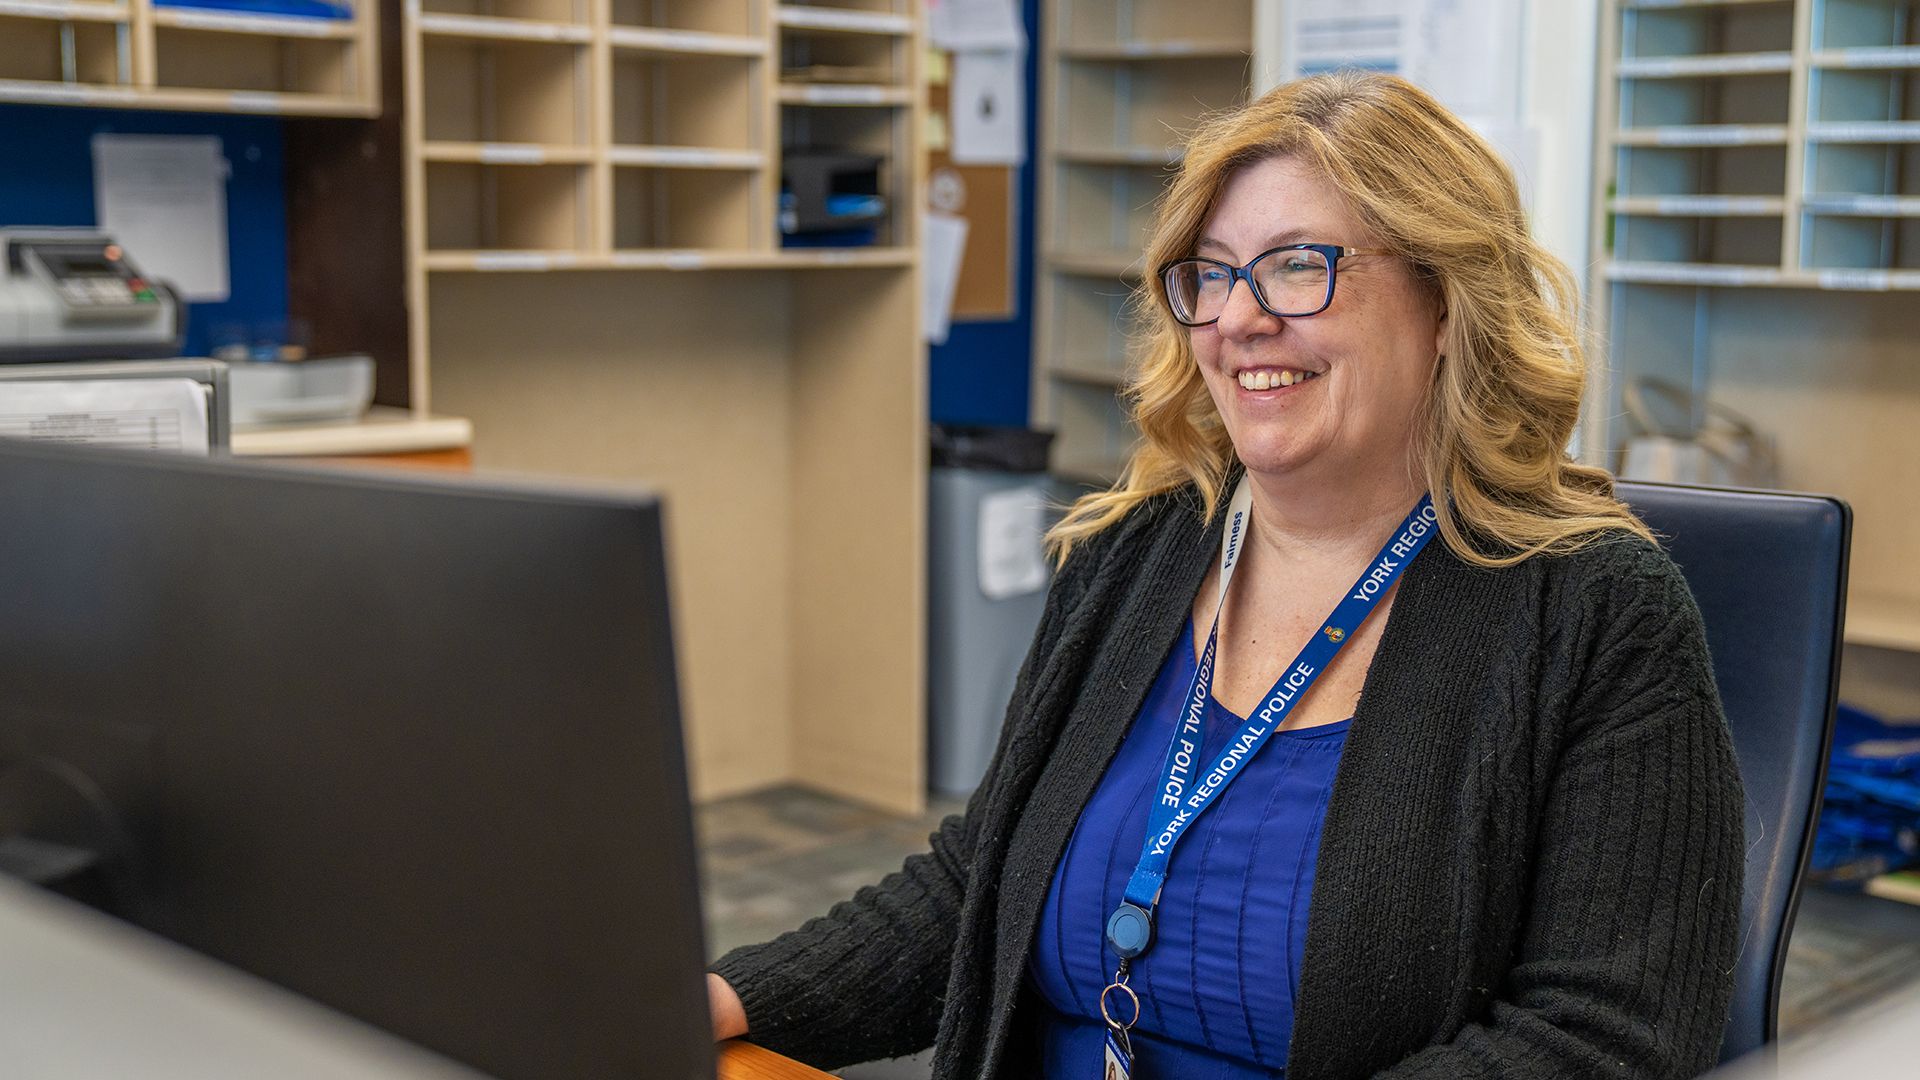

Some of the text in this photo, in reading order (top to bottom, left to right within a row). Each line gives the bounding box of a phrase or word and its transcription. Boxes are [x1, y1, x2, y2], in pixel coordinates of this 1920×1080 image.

[1224, 511, 1243, 570] Fairness
[1353, 502, 1437, 602] YORK REGIO
[1150, 661, 1315, 855] YORK REGIONAL POLICE
[1161, 641, 1215, 808] REGIONAL POLICE
